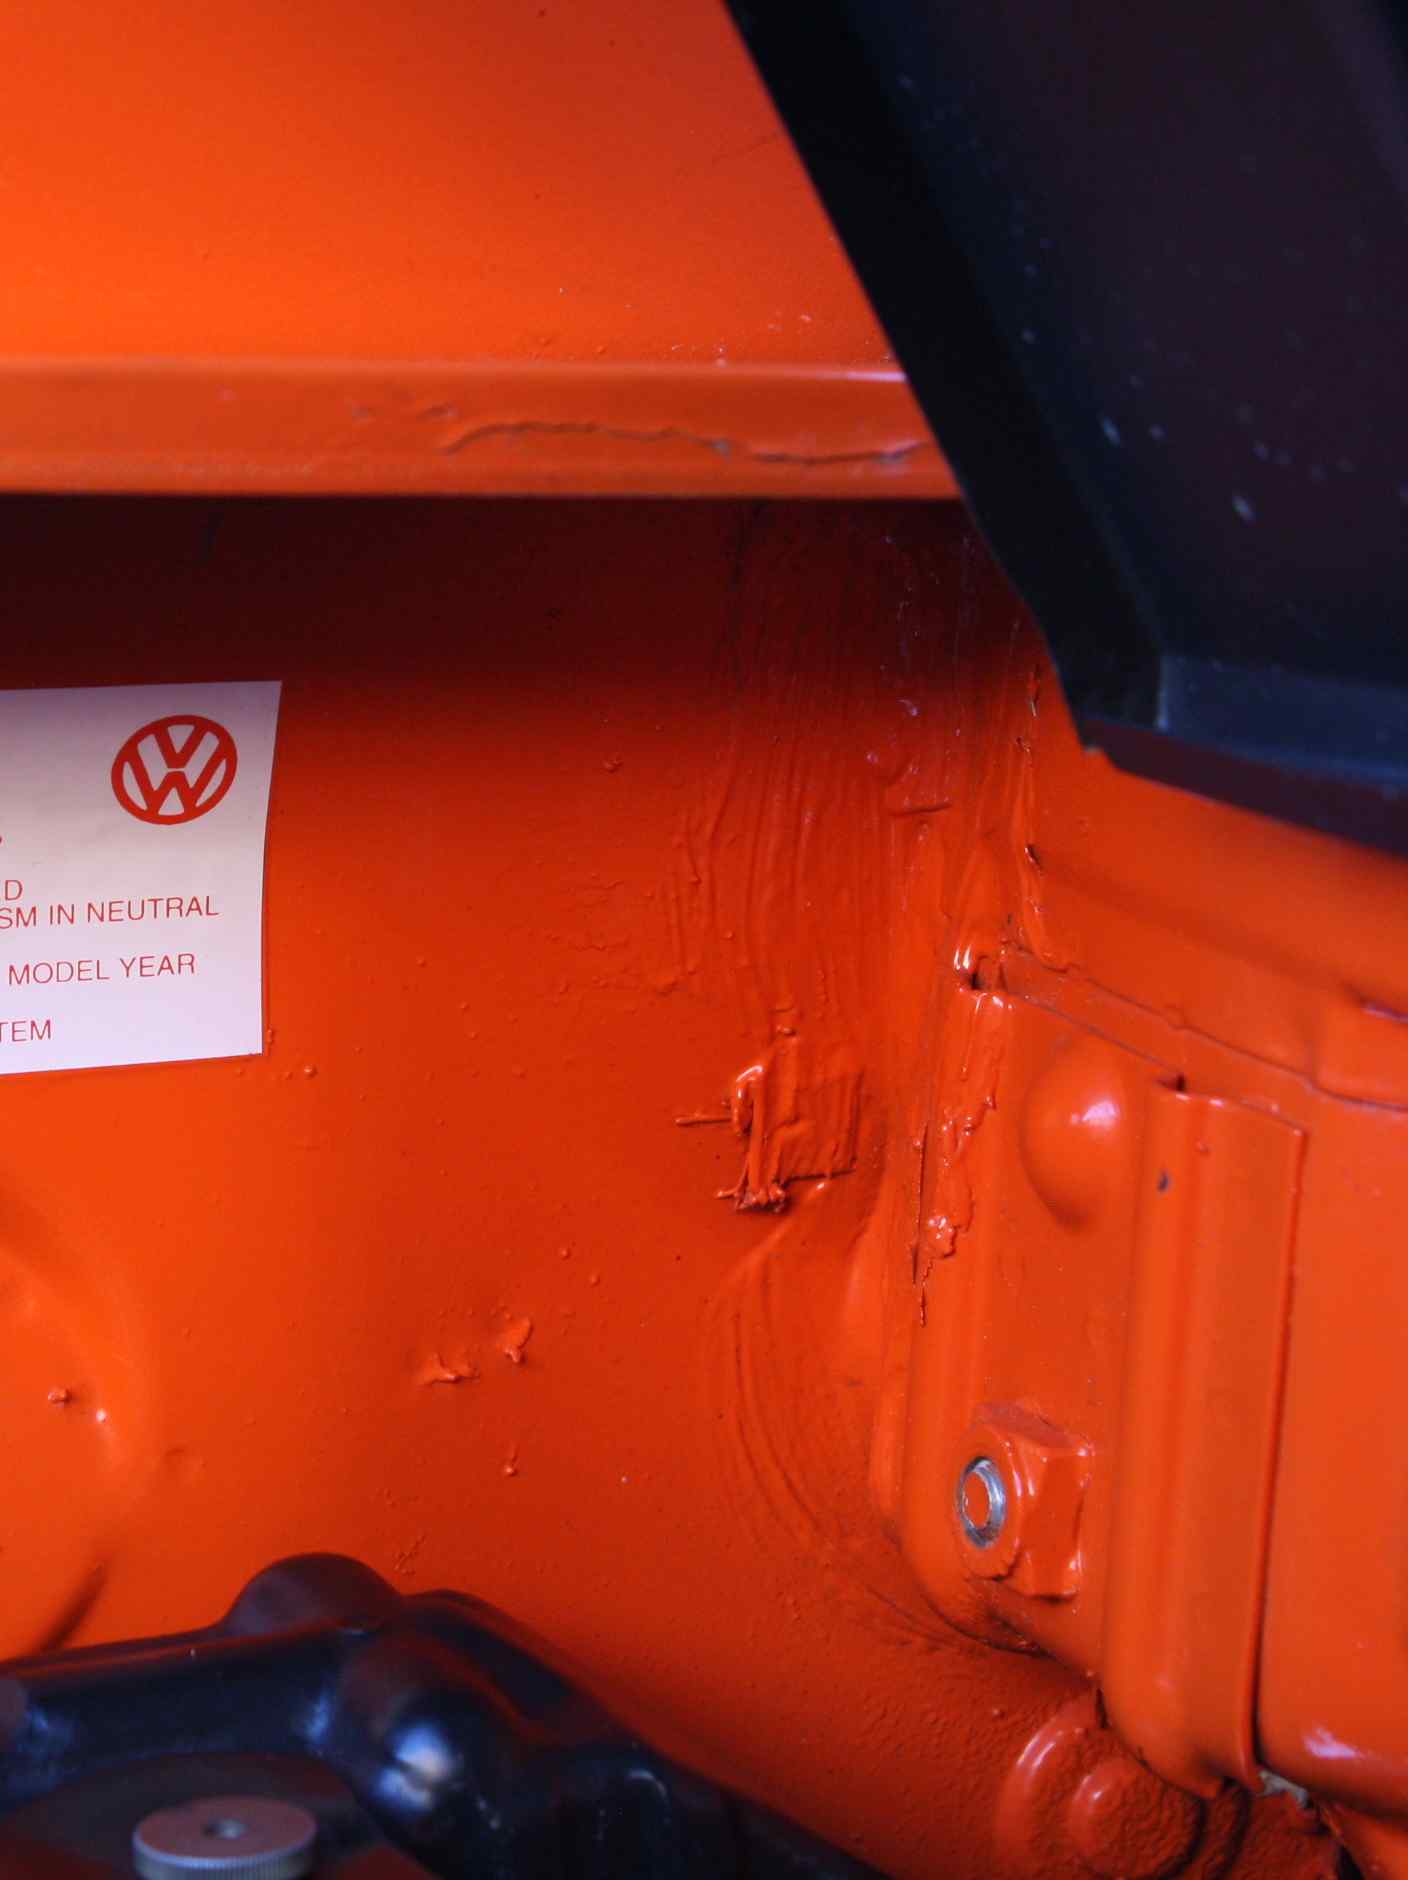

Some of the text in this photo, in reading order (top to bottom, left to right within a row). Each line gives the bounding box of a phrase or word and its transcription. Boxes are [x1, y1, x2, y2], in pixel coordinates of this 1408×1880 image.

[111, 714, 238, 825] VW
[50, 904, 74, 925] IN
[88, 896, 219, 923] NEUTRAL
[9, 960, 110, 986] MODEL
[120, 953, 195, 978] YEAR
